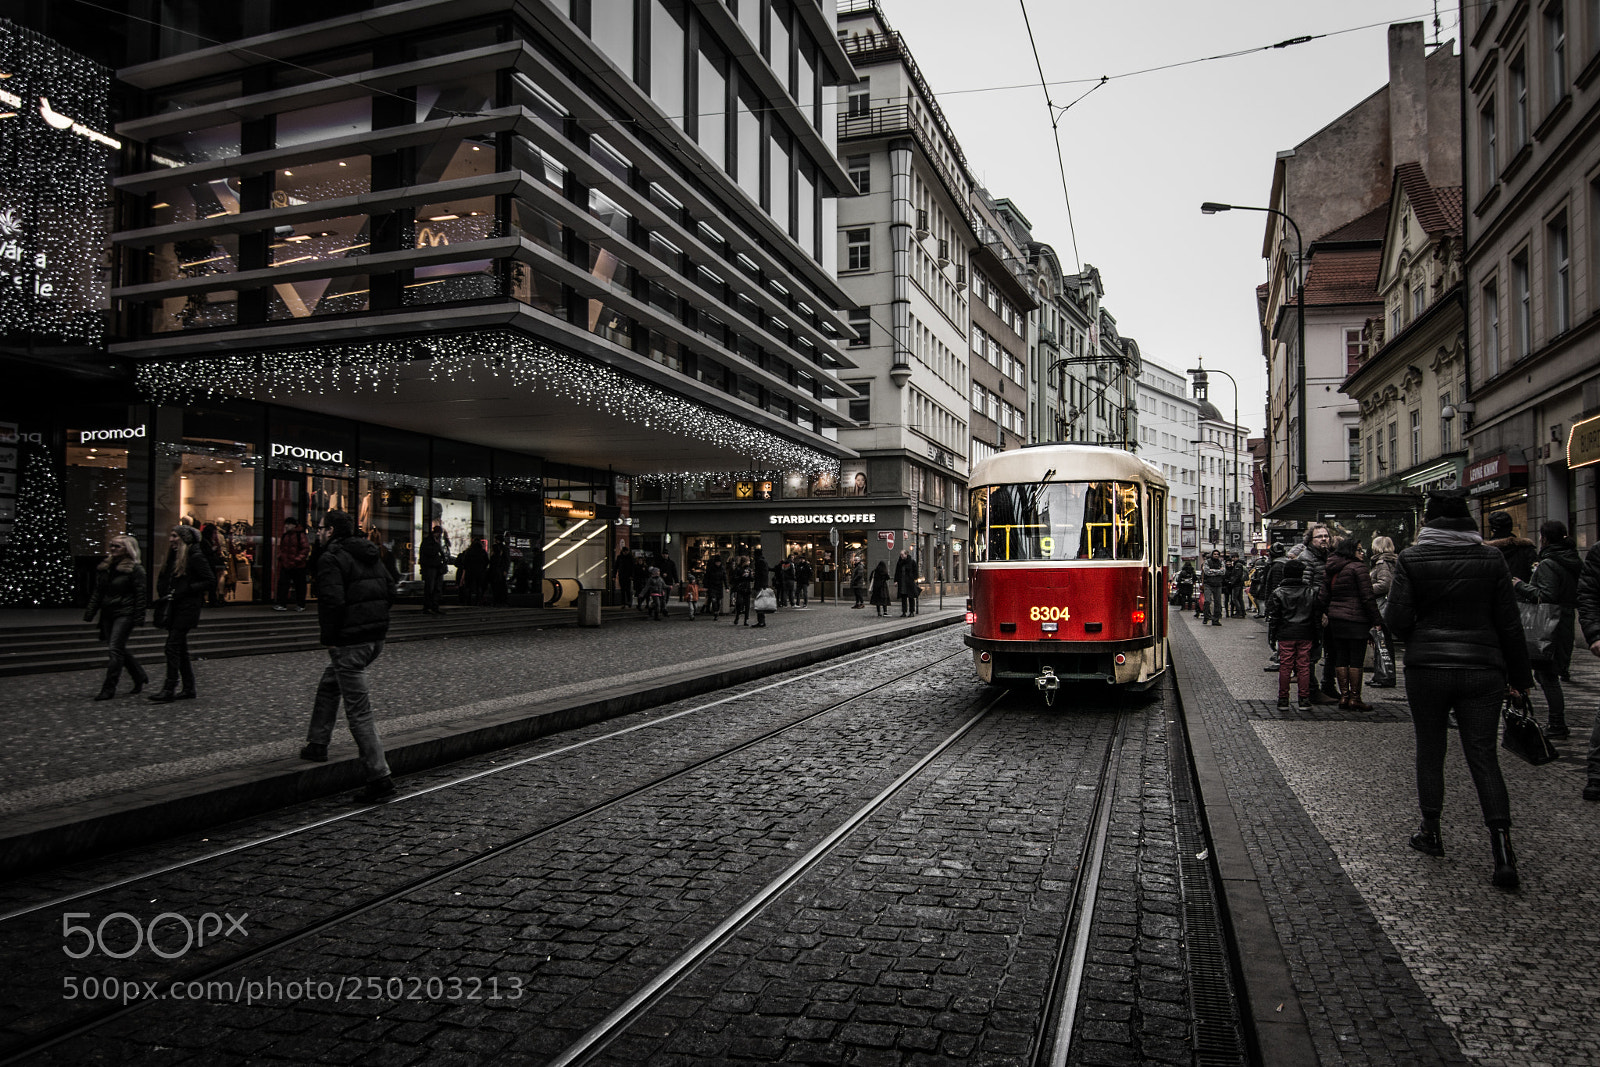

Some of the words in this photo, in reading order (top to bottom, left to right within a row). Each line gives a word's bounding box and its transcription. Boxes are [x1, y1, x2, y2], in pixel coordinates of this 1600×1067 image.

[81, 424, 146, 444] promod
[271, 443, 343, 463] promod
[769, 514, 834, 525] STARBUCKS
[834, 513, 876, 523] COFFEE
[1040, 536, 1055, 557] 9
[1030, 606, 1070, 621] 8304
